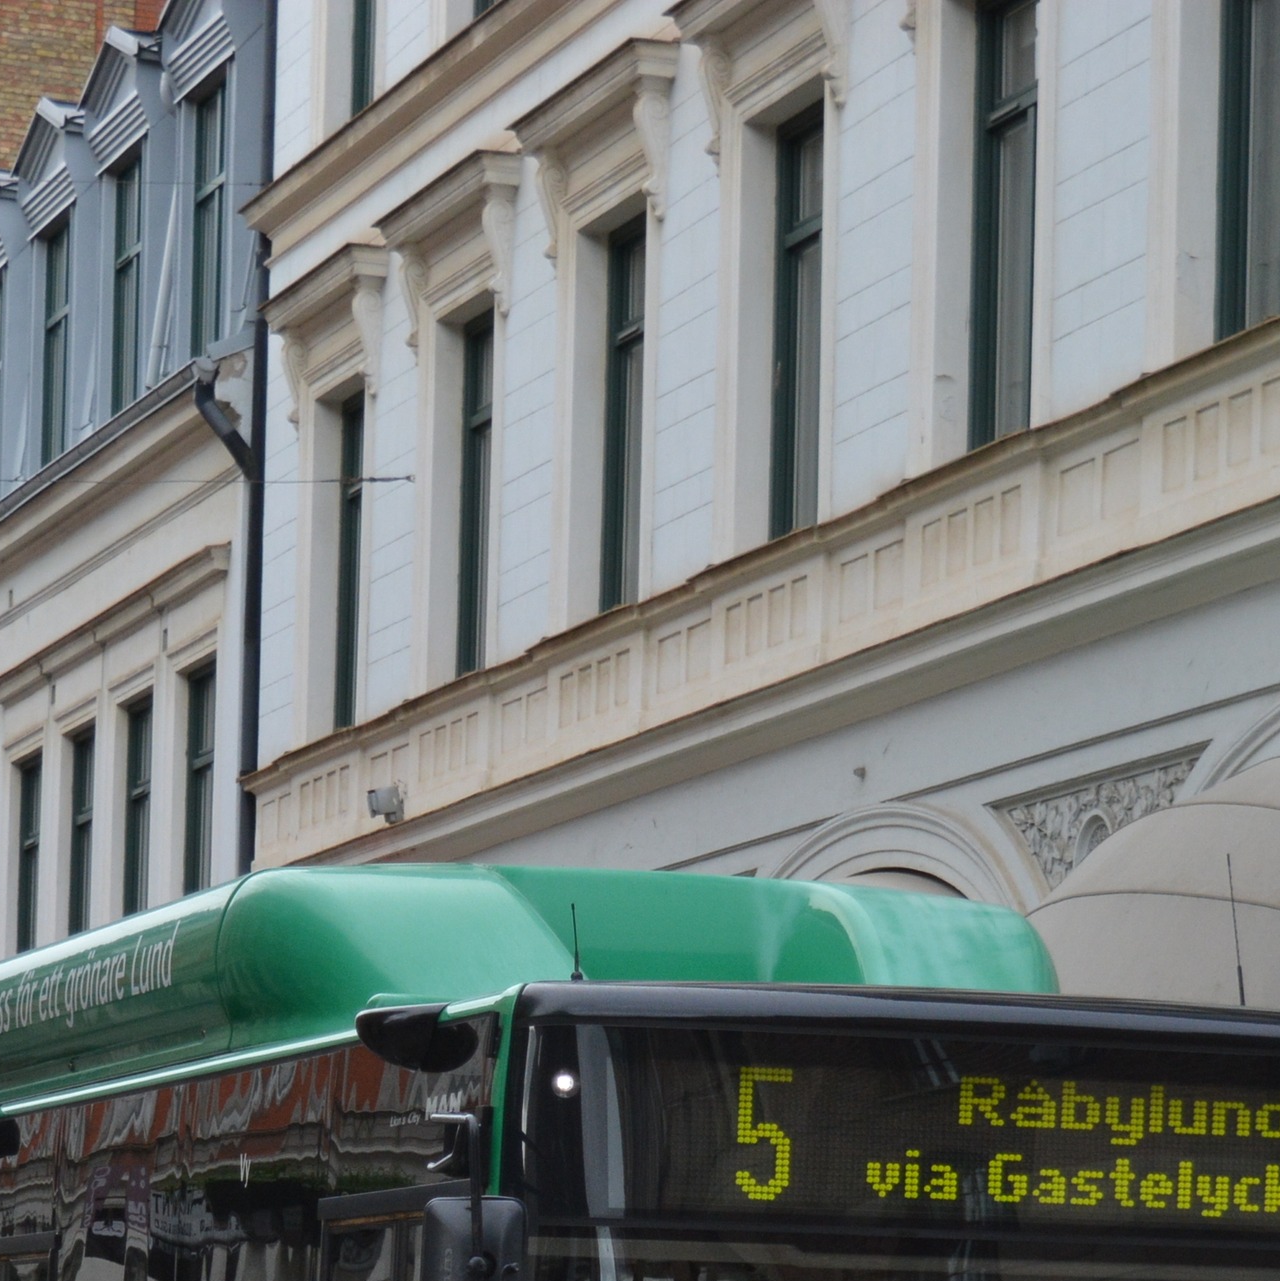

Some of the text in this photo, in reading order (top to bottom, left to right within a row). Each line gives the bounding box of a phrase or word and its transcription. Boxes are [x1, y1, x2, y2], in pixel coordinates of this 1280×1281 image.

[16, 969, 38, 1028] för
[39, 964, 64, 1021] ett
[64, 950, 127, 1028] grönare
[131, 920, 181, 996] Lund
[425, 1089, 463, 1121] MAN
[735, 1065, 793, 1201] 5
[866, 1149, 958, 1200] via
